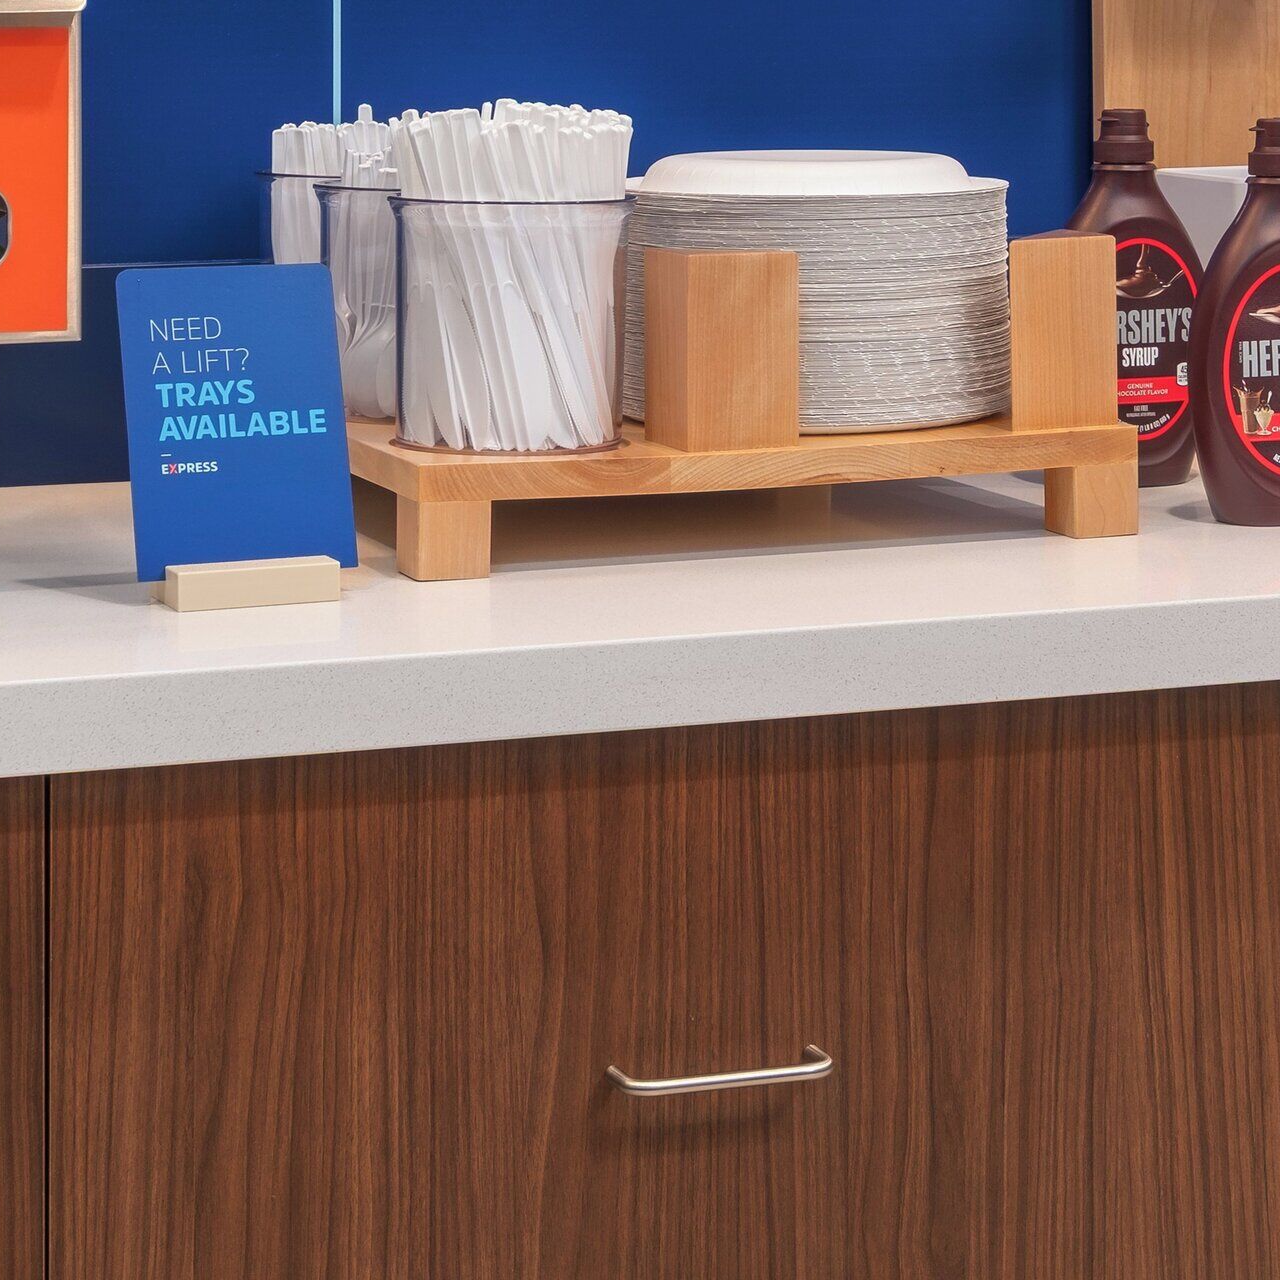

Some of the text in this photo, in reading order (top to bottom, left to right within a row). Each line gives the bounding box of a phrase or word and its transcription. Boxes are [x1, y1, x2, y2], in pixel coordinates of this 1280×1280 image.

[149, 316, 222, 342] NEED
[1116, 307, 1192, 345] RSHEY'S
[152, 347, 250, 375] A LIFT?
[1122, 347, 1159, 367] SYRUP
[155, 379, 256, 408] TRAYS
[159, 408, 327, 442] AVAILABLE
[161, 461, 218, 475] EXPRESS
